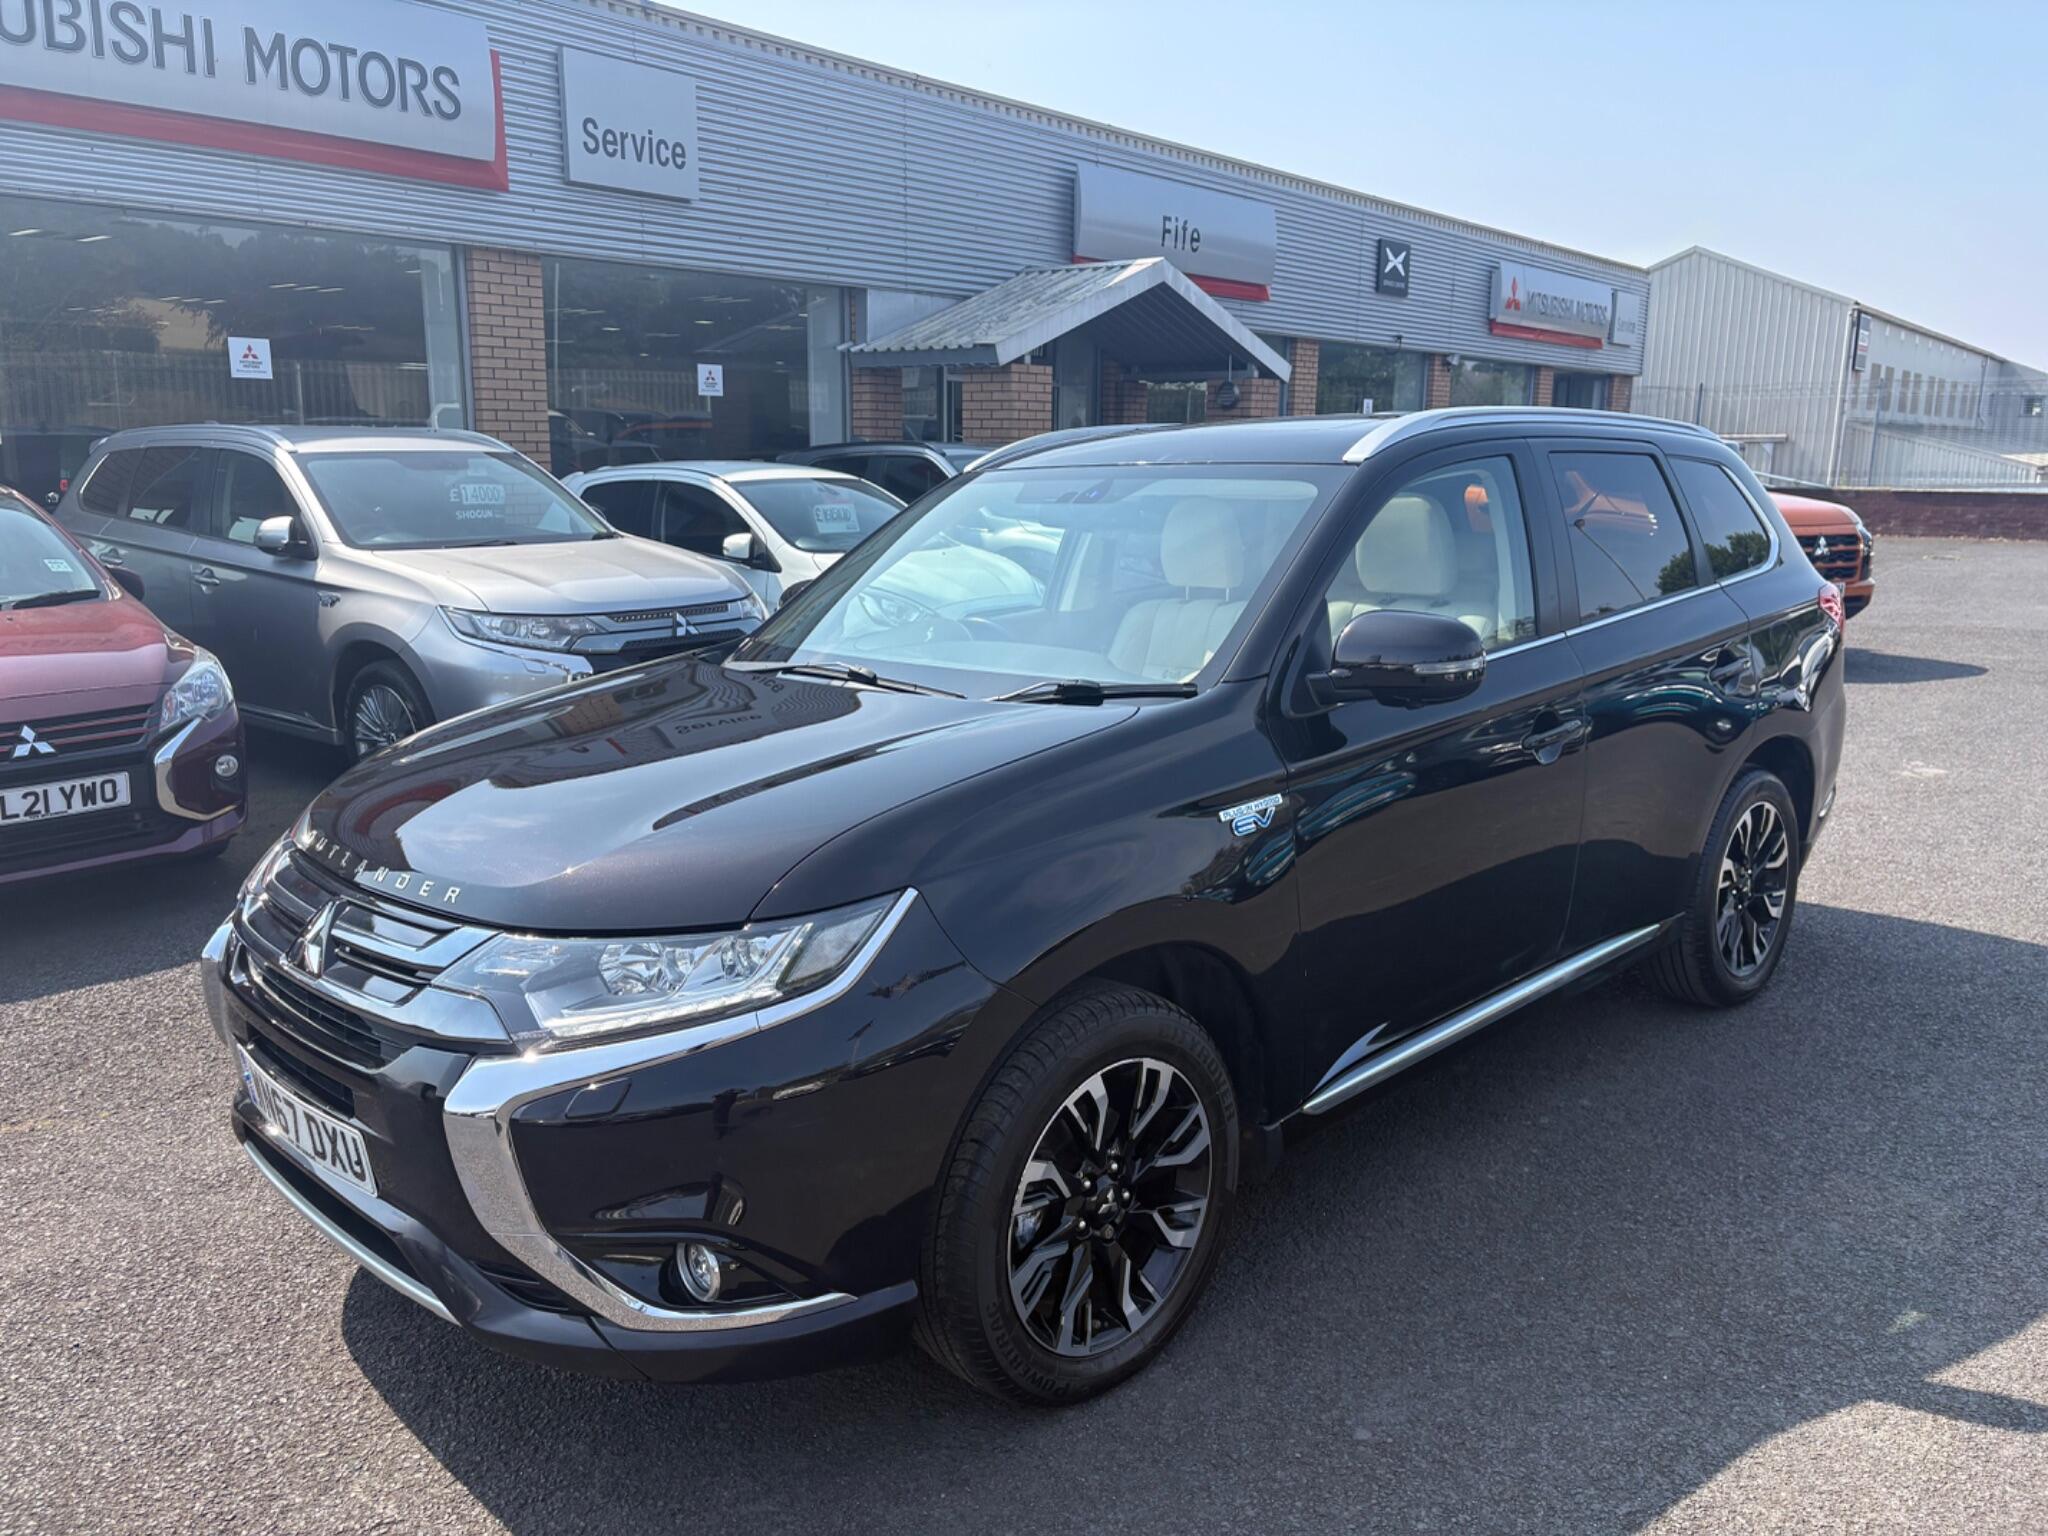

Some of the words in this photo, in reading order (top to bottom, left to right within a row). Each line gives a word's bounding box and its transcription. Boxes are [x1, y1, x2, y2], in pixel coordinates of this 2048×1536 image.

[242, 25, 462, 120] MOTORS
[582, 116, 687, 170] Service
[1160, 214, 1201, 253] Fife
[58, 778, 119, 811] YWO
[1231, 806, 1276, 837] EV
[302, 830, 461, 904] OUTLANDER
